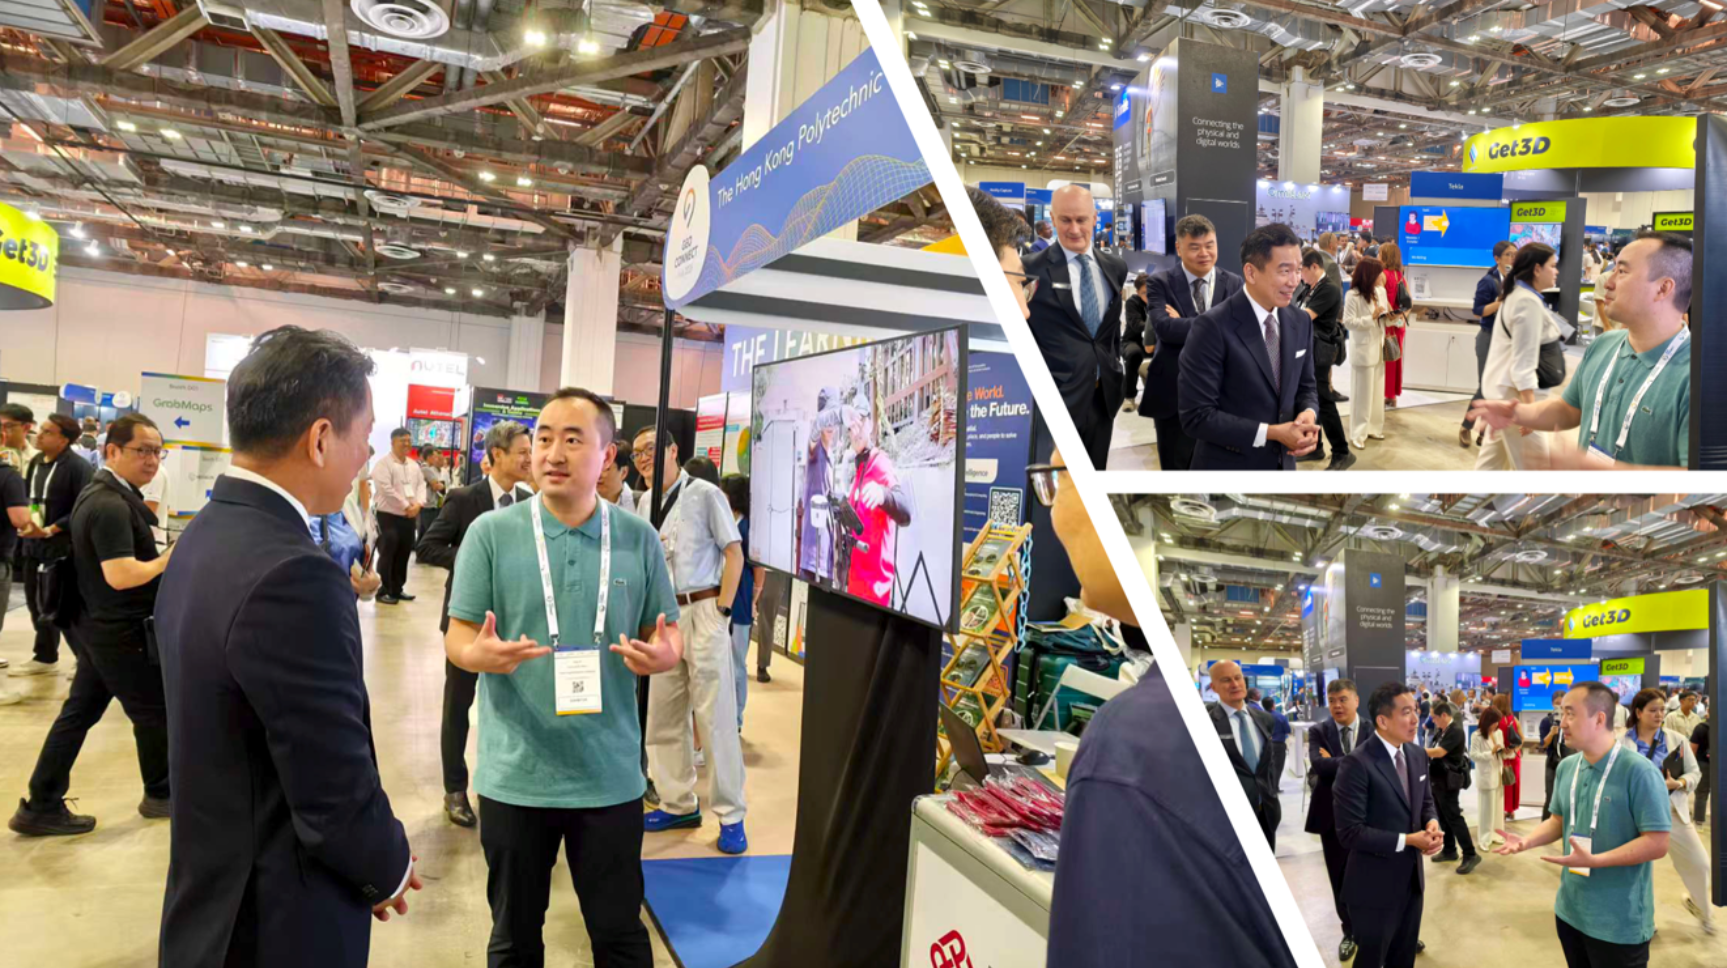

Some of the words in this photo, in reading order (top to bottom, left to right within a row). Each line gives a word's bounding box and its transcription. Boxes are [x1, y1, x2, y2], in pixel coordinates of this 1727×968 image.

[1192, 116, 1231, 131] Connecting
[1232, 121, 1244, 130] the
[717, 186, 733, 209] The
[735, 165, 762, 196] Hong
[764, 140, 795, 175] Kong
[798, 70, 883, 150] Polytechnic
[1197, 127, 1224, 138] physical
[1226, 131, 1240, 140] and
[1195, 136, 1217, 148] digital
[1217, 140, 1241, 149] worlds
[1488, 136, 1551, 160] Get3D
[1516, 207, 1546, 217] Get3D
[1660, 217, 1692, 226] Get3D
[0, 229, 49, 272] et3D
[674, 245, 698, 268] CONNECT
[975, 385, 1004, 400] World.
[153, 398, 213, 413] GrabMaps
[970, 403, 987, 418] the
[989, 401, 1030, 418] Future.
[1356, 605, 1385, 616] Connecting
[1386, 608, 1396, 616] the
[1360, 614, 1381, 622] physical
[1360, 620, 1375, 630] digital
[1583, 608, 1631, 629] Get3D
[1606, 662, 1629, 671] Get3D
